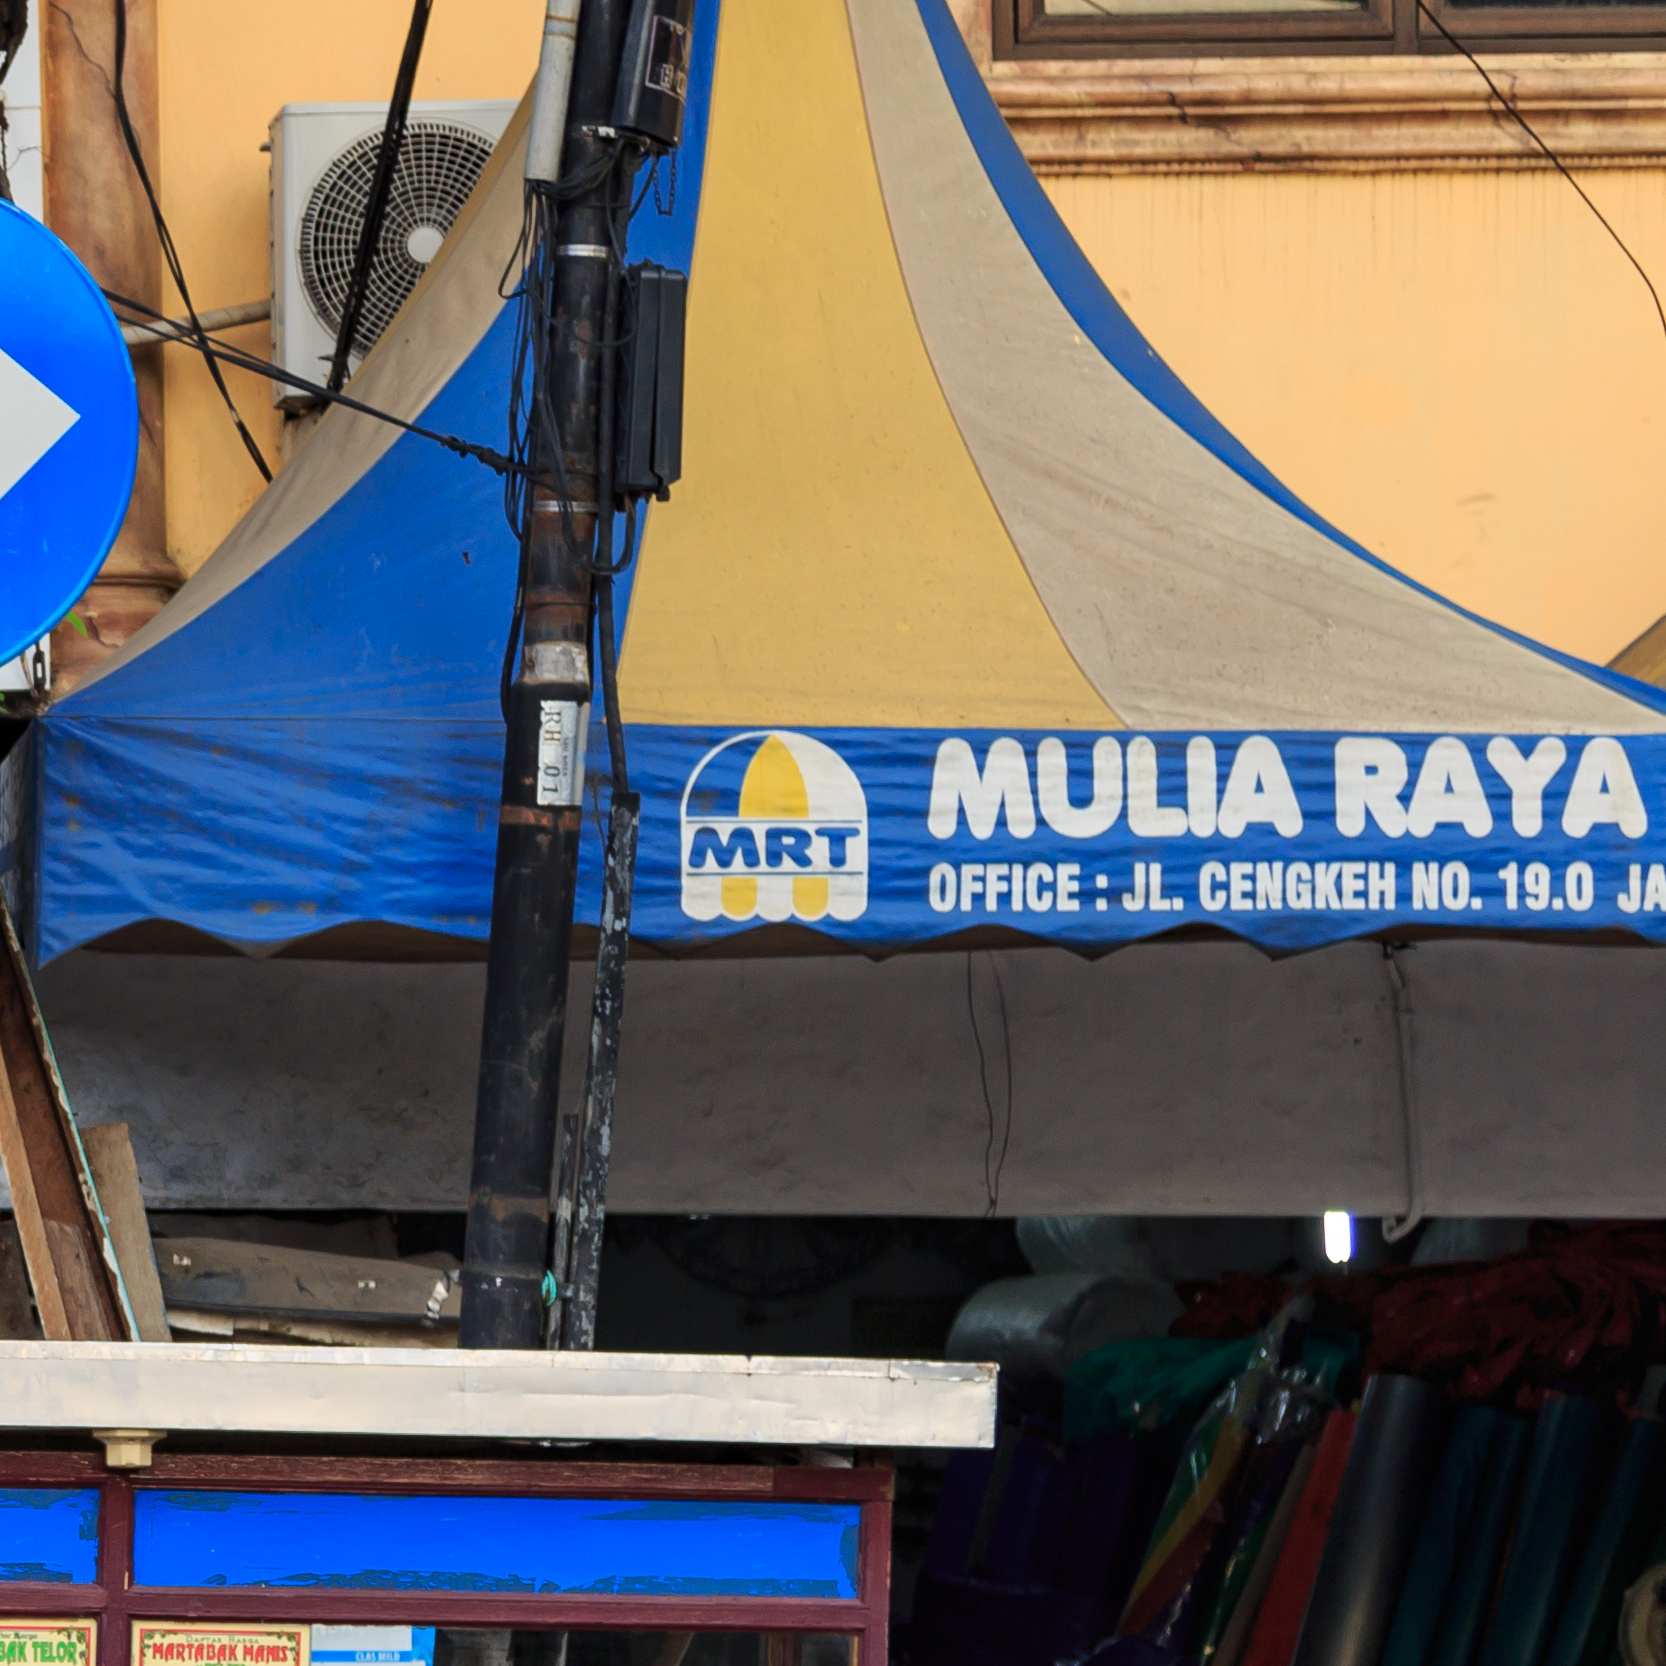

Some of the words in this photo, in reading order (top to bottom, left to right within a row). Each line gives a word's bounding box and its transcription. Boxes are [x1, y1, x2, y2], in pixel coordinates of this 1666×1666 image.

[927, 735, 1303, 840] MULIA
[1335, 736, 1649, 839] RAYA
[688, 826, 860, 868] MRT
[928, 862, 1081, 912] OFFICE
[1122, 861, 1185, 912] JL.
[1199, 861, 1397, 911] CENGKEH
[1412, 861, 1483, 911] NO.
[32, 1641, 77, 1666] TELOR
[152, 1642, 239, 1664] MARTABAK
[243, 1645, 289, 1665] MANIS
